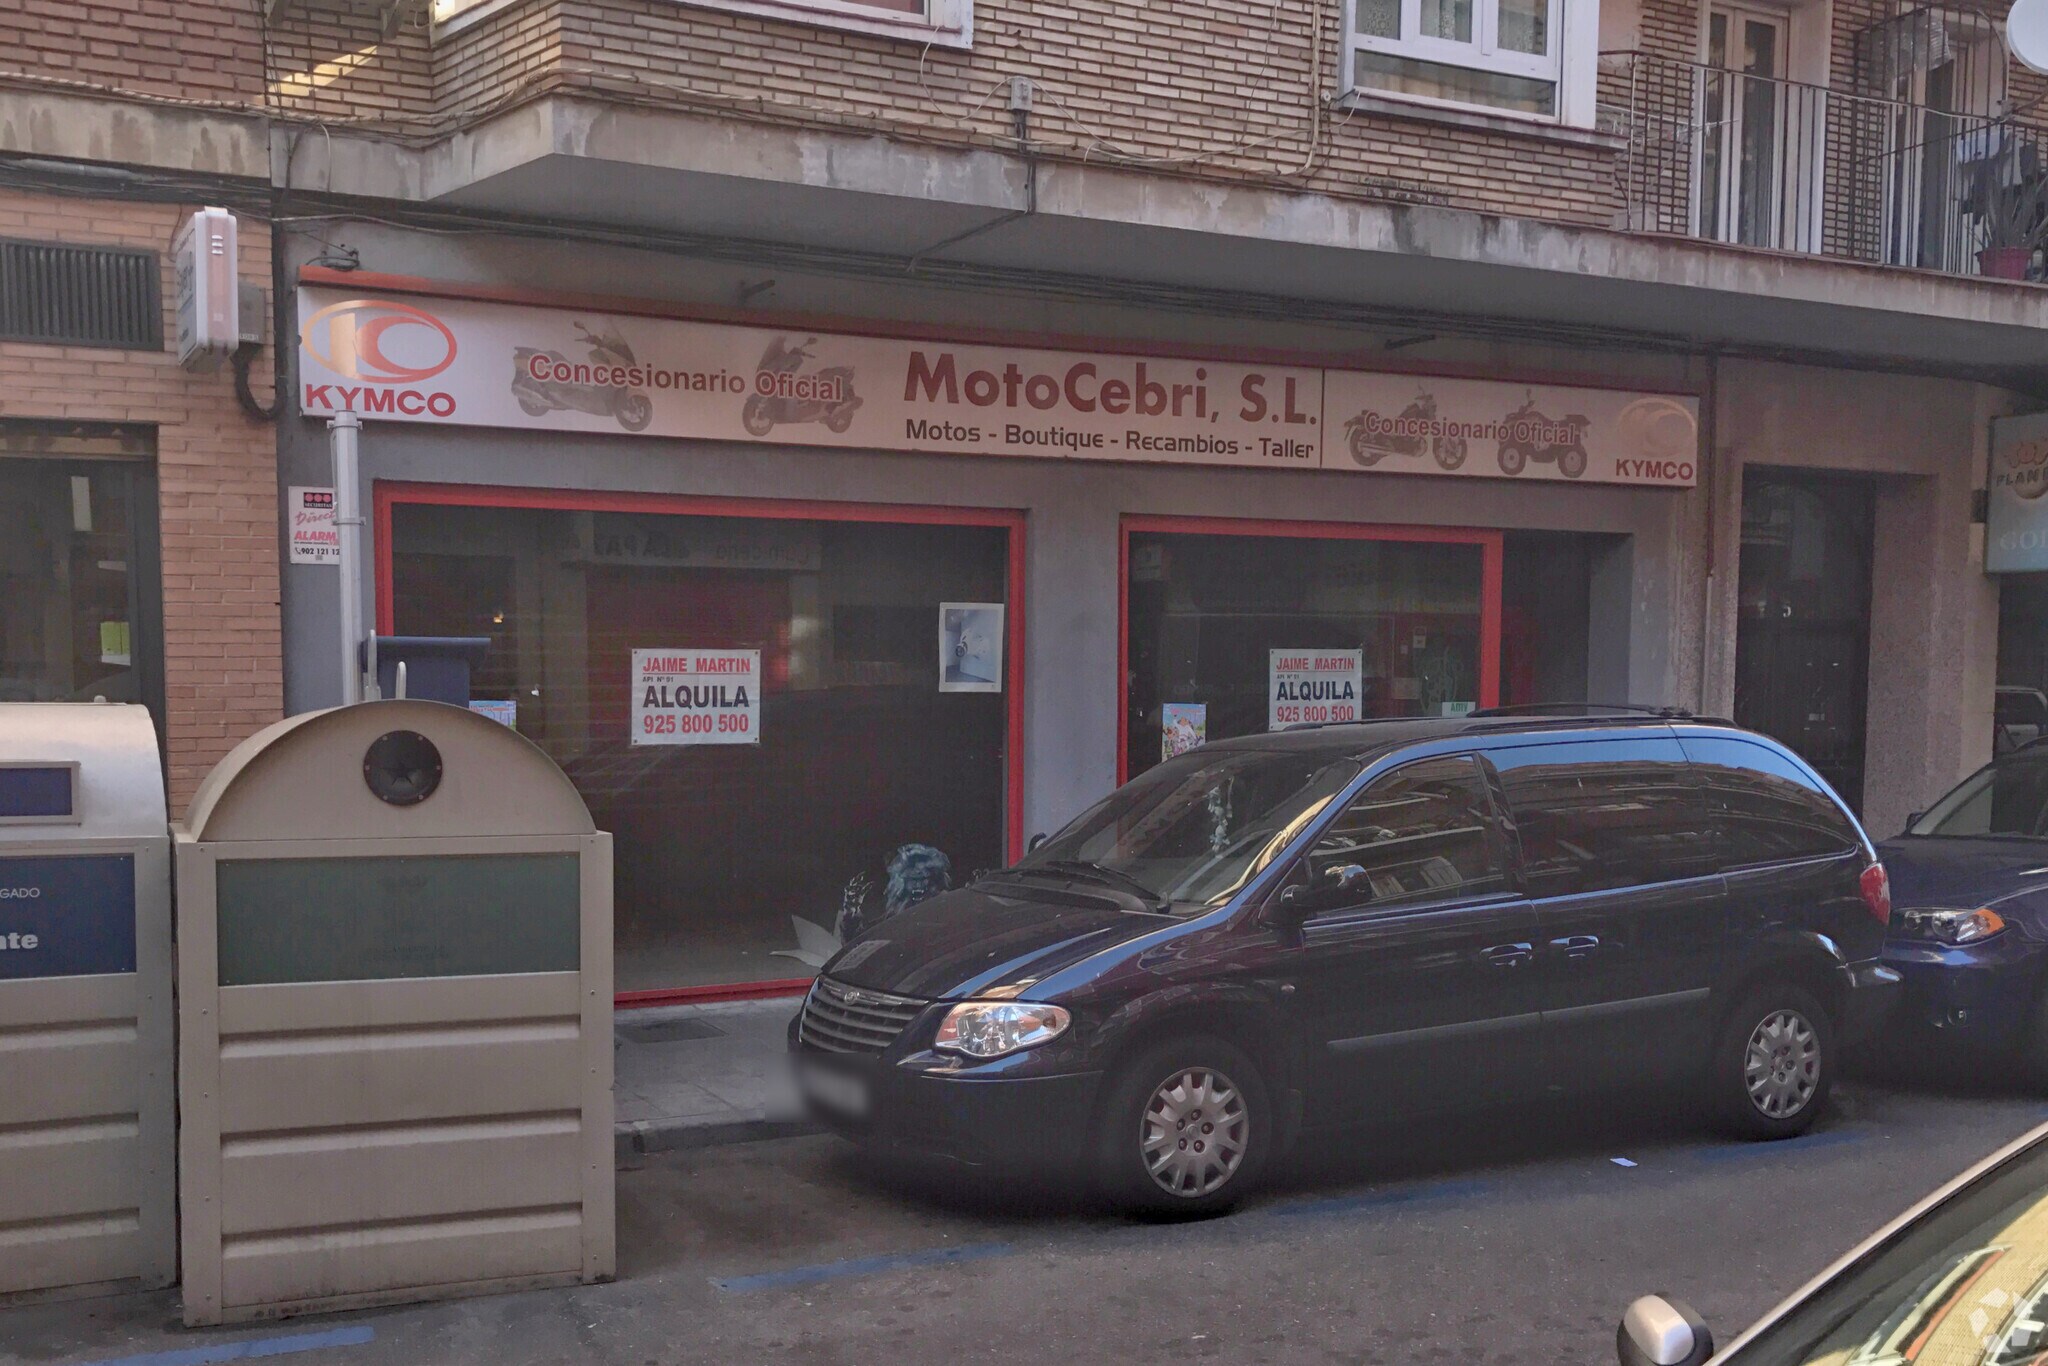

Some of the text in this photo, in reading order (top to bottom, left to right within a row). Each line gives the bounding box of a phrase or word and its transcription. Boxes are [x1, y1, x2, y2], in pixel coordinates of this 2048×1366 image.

[529, 354, 842, 400] Concesionario Oficial
[305, 383, 457, 418] KYMCO
[1239, 374, 1317, 425] S.L.
[906, 418, 981, 443] Motos
[1005, 423, 1103, 451] Boutique
[1126, 430, 1238, 455] Recambios
[1259, 437, 1314, 459] Taller
[1365, 412, 1576, 444] Concesionario Oficial
[1615, 458, 1694, 481] KYMCO
[301, 547, 314, 555] 902
[317, 547, 329, 555] 121
[643, 657, 751, 673] JAIME MARTIN
[1276, 657, 1355, 671] JAIME MARTIN
[643, 685, 750, 710] ALQUILA
[1276, 681, 1354, 701] ALQUILA
[643, 713, 749, 734] 925 800 500
[1277, 705, 1354, 722] 925 800 500
